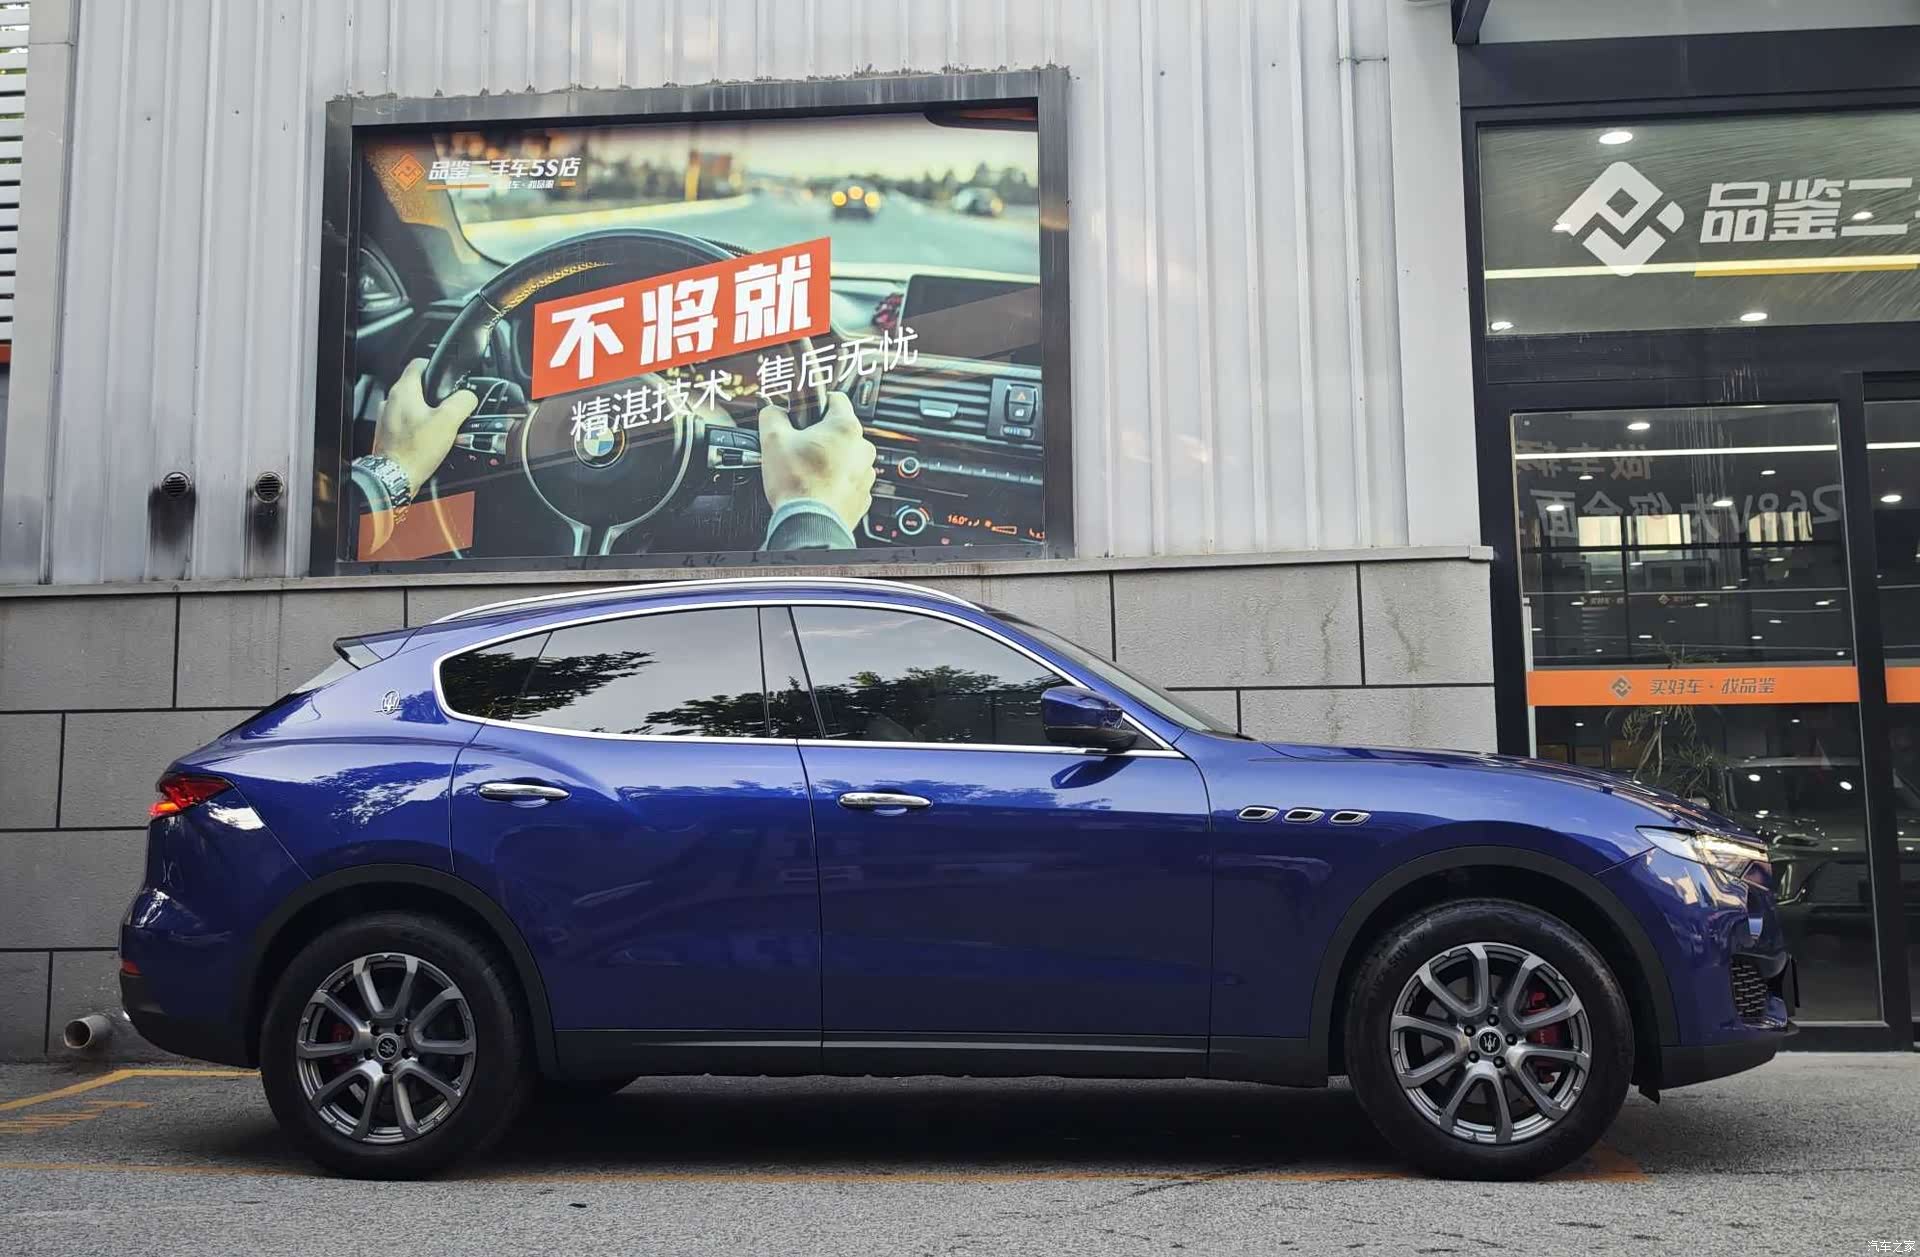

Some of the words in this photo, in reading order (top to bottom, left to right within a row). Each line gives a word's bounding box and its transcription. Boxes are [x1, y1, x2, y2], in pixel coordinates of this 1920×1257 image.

[428, 157, 582, 180] 品鉴二手车5S店
[1700, 177, 1920, 243] 品鉴二
[549, 253, 812, 380] 不将就
[570, 369, 733, 441] 精湛技术
[756, 325, 919, 398] 售后无忧
